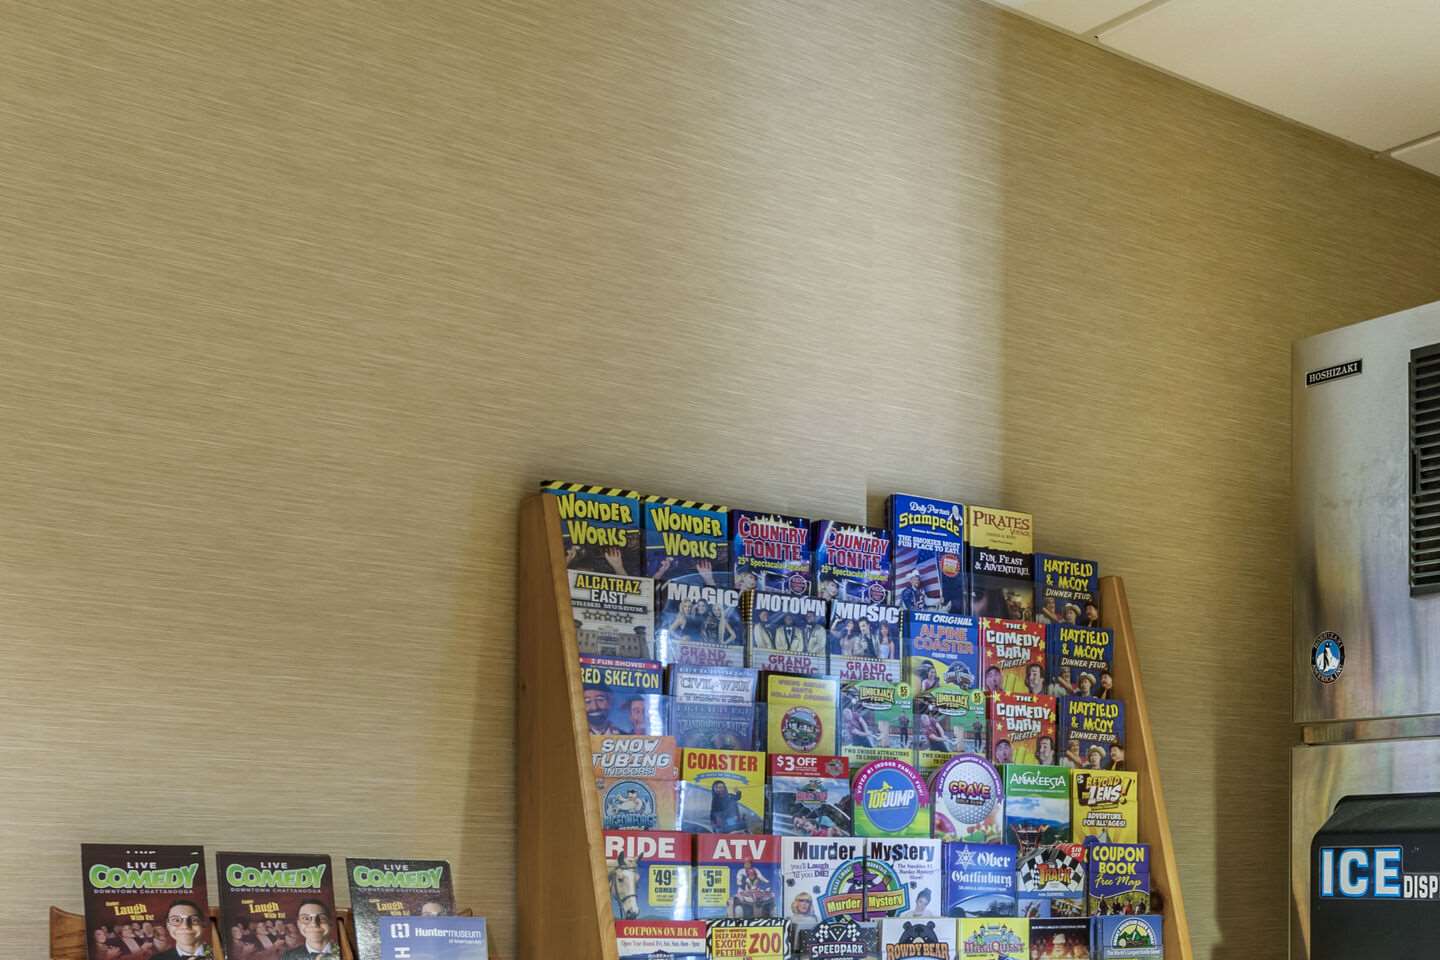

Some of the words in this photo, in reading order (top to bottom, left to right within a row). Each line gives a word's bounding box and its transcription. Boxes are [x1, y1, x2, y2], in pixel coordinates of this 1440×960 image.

[1308, 362, 1359, 384] HOSHIZAKI
[557, 493, 633, 524] WONDER
[650, 507, 723, 537] WONDER
[900, 512, 960, 536] Stampede
[973, 510, 1031, 530] PIRATES
[568, 520, 627, 548] WORKS
[738, 518, 809, 545] COUNTRY
[663, 533, 718, 560] WORKS
[743, 538, 802, 561] TONITE
[999, 555, 1023, 567] FEAST
[1043, 559, 1093, 577] HATFIELD
[575, 574, 641, 594] ALCATRAZ
[1046, 574, 1053, 585] &
[591, 589, 626, 604] EAST
[667, 583, 740, 608] MAGIC
[1045, 588, 1071, 598] DINNER
[1074, 590, 1091, 600] FEUD
[756, 593, 826, 617] MOTOWN
[836, 603, 899, 623] MUSIC
[914, 613, 935, 622] THE
[937, 614, 973, 626] ORIGINAL
[986, 630, 1041, 646] COMEDY
[996, 645, 1031, 660] BARN
[605, 669, 659, 689] SKELTON
[602, 738, 660, 752] SNOW
[592, 752, 672, 768] TUBING
[687, 752, 758, 772] COASTER
[776, 756, 795, 771] $3
[797, 757, 817, 767] OFF
[949, 780, 990, 796] CRAVE
[605, 837, 675, 859] RIDE
[712, 839, 766, 859] ATV
[793, 841, 856, 860] Murder
[870, 840, 935, 862] Mystery
[1092, 846, 1144, 863] COUPON
[89, 863, 199, 889] COMEDY
[226, 864, 326, 888] COMEDY
[1099, 861, 1136, 875] BOOK
[1321, 848, 1400, 897] ICE
[1094, 874, 1114, 888] Free
[1116, 876, 1142, 890] Map
[749, 932, 782, 954] ZOO
[811, 943, 864, 958] SPEEDPARK
